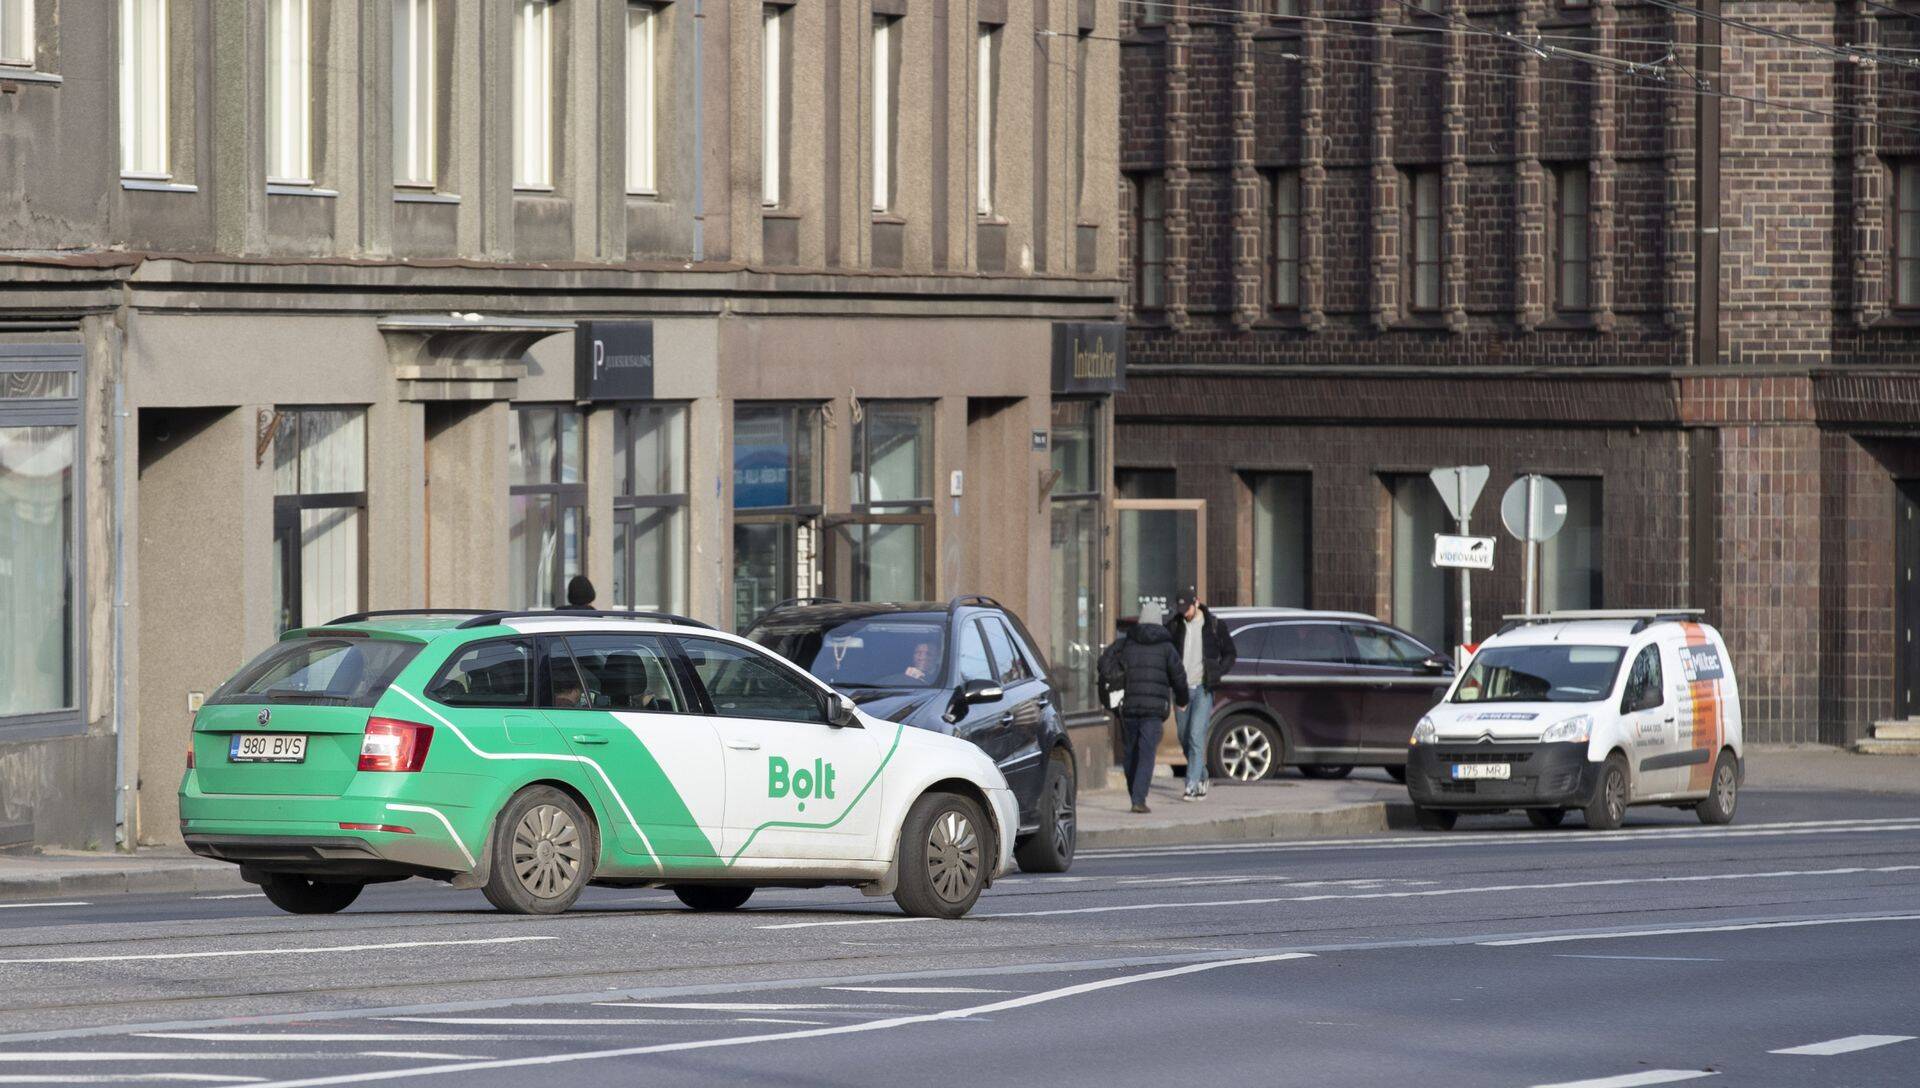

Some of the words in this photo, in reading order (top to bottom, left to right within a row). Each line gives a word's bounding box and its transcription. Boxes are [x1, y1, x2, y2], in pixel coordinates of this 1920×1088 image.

[1440, 551, 1489, 563] VIDEOVALVE
[243, 738, 266, 754] 980
[273, 738, 302, 754] BVS
[1463, 765, 1478, 777] 175
[1486, 764, 1507, 777] MRJ
[768, 755, 836, 812] Bolt
